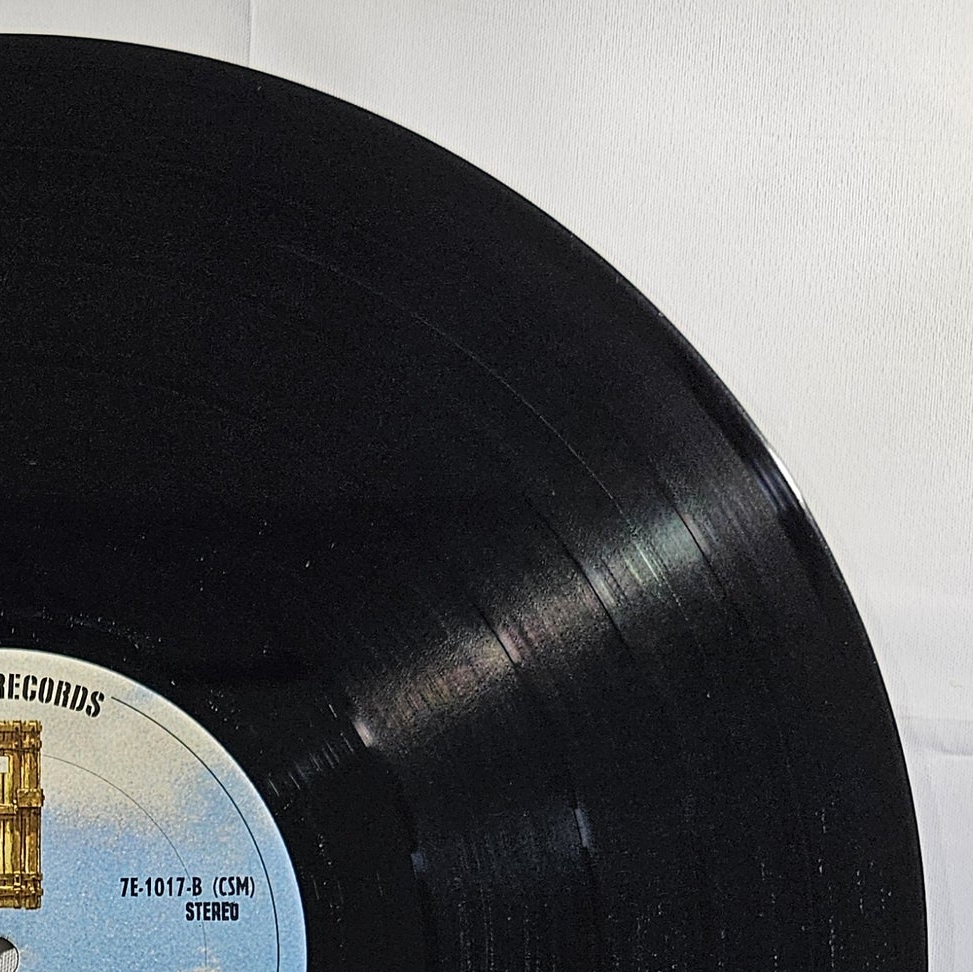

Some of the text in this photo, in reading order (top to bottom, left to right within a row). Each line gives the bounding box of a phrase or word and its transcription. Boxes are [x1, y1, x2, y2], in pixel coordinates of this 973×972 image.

[120, 876, 255, 898] 7E-1017-B (CSM)
[185, 901, 239, 921] STEREO
